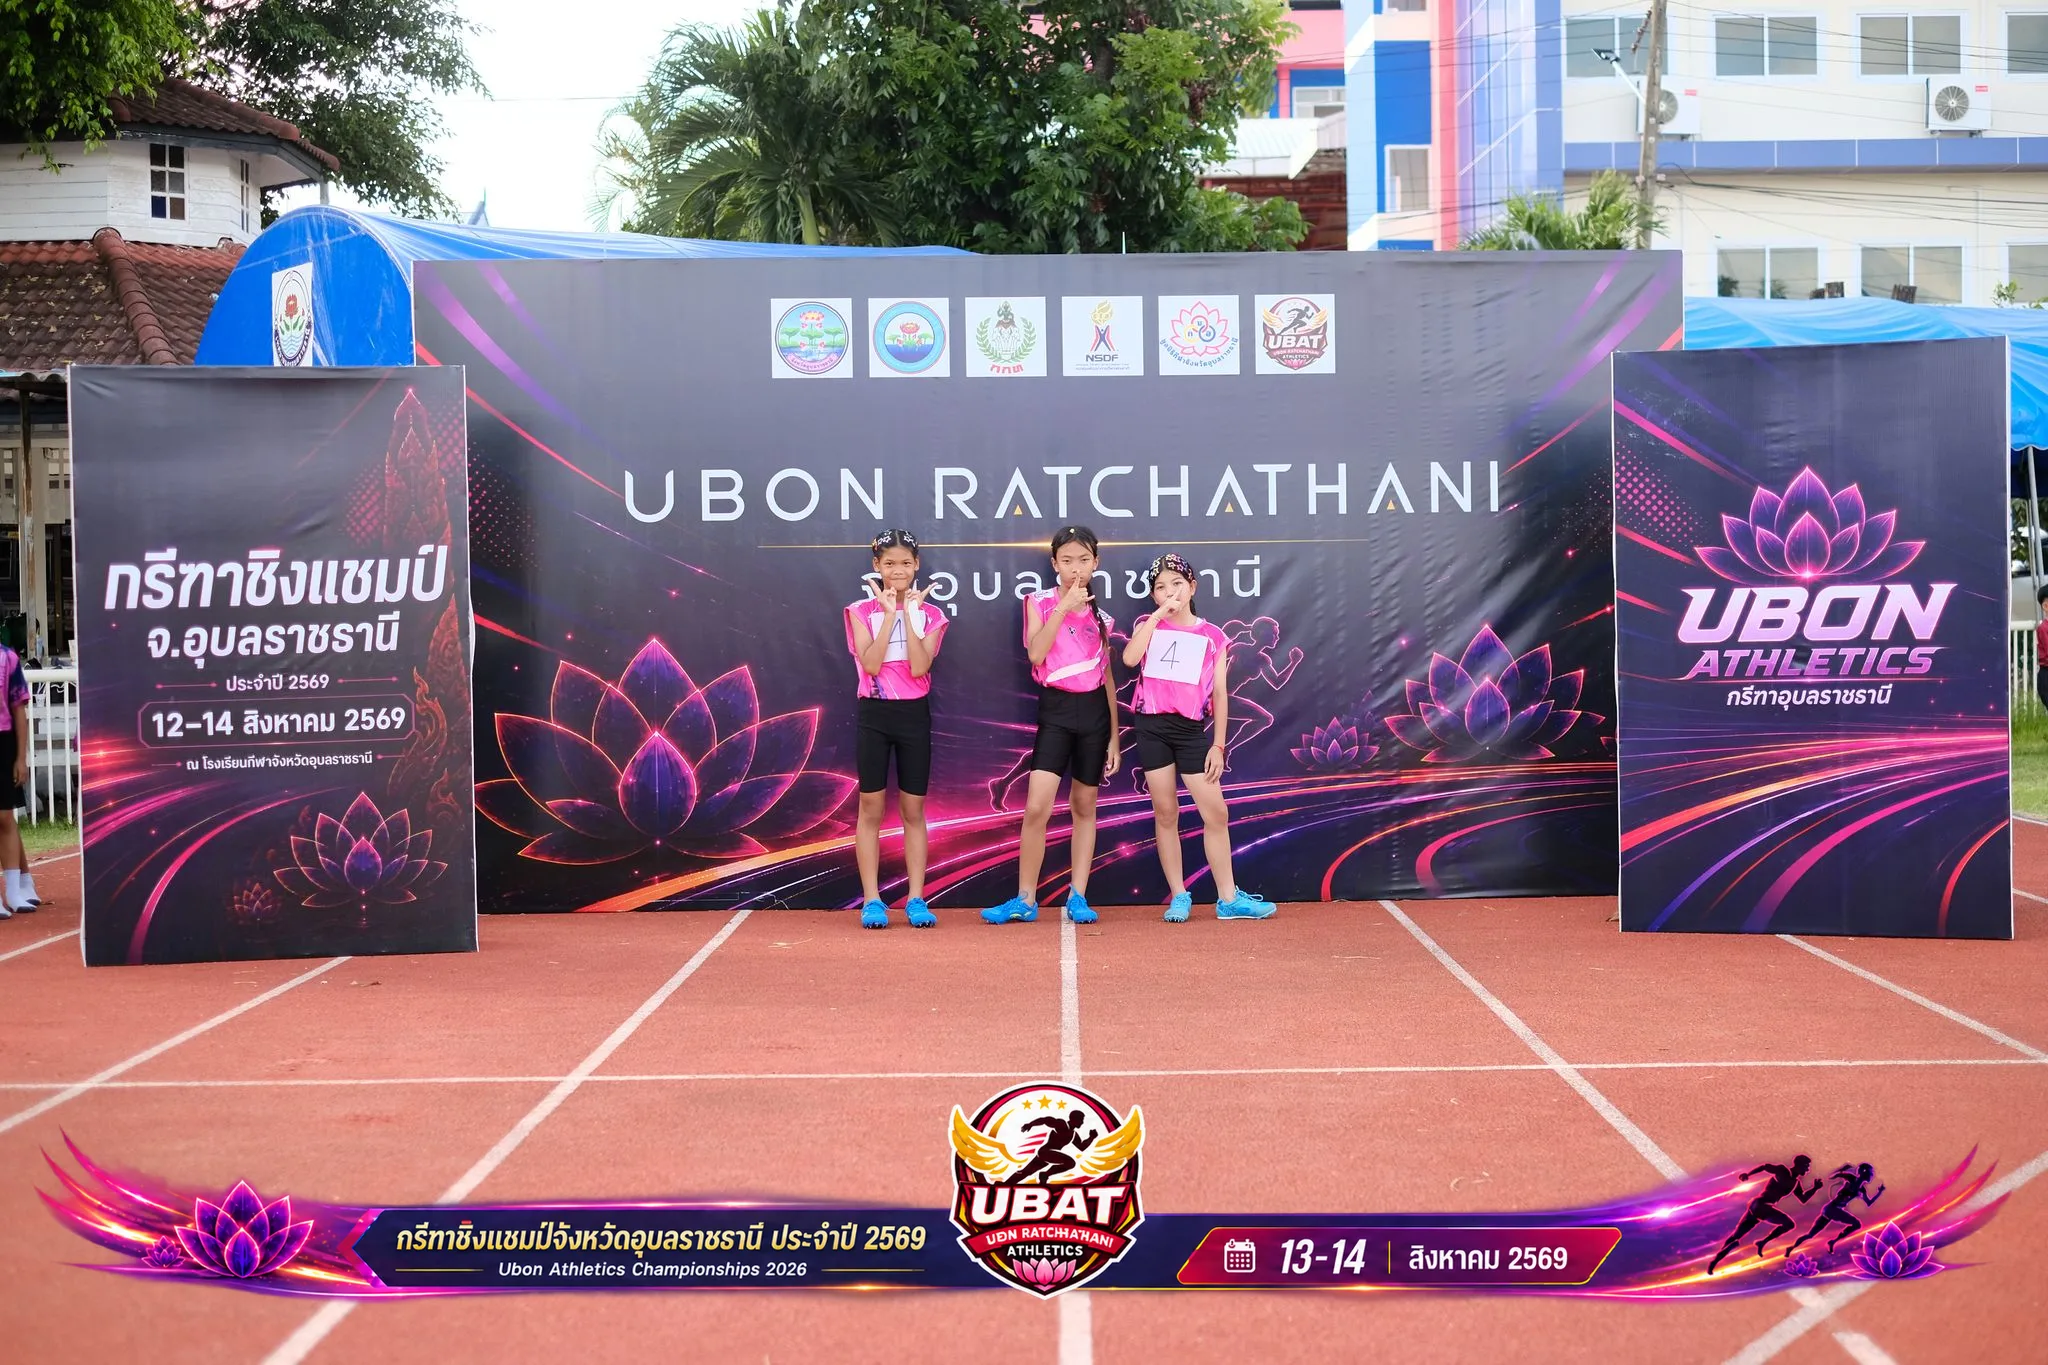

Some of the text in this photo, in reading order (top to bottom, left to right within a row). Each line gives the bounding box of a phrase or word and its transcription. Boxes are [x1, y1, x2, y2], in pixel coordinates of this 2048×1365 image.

[1268, 334, 1323, 350] UBAT
[990, 363, 1024, 374] กกท
[1085, 354, 1119, 362] NSDF
[624, 460, 1499, 523] UBON RATCHATHANI
[104, 543, 449, 610] กรีฑาชิงแชมป์
[1677, 583, 1958, 643] UBON
[147, 610, 401, 669] จ.อุบลราชธานี
[888, 618, 908, 649] 4
[1160, 640, 1180, 670] 4
[1684, 646, 1948, 680] ATHLETICS
[226, 673, 330, 692] ประจำปี 2569
[1726, 683, 1893, 712] กรีฑาอุบลราชธานี
[243, 709, 336, 735] สิงหาคม
[344, 706, 406, 731] 2569
[186, 750, 373, 771] ณ โรงเรียนกีฬาจังหวัดอุบลราชธานี
